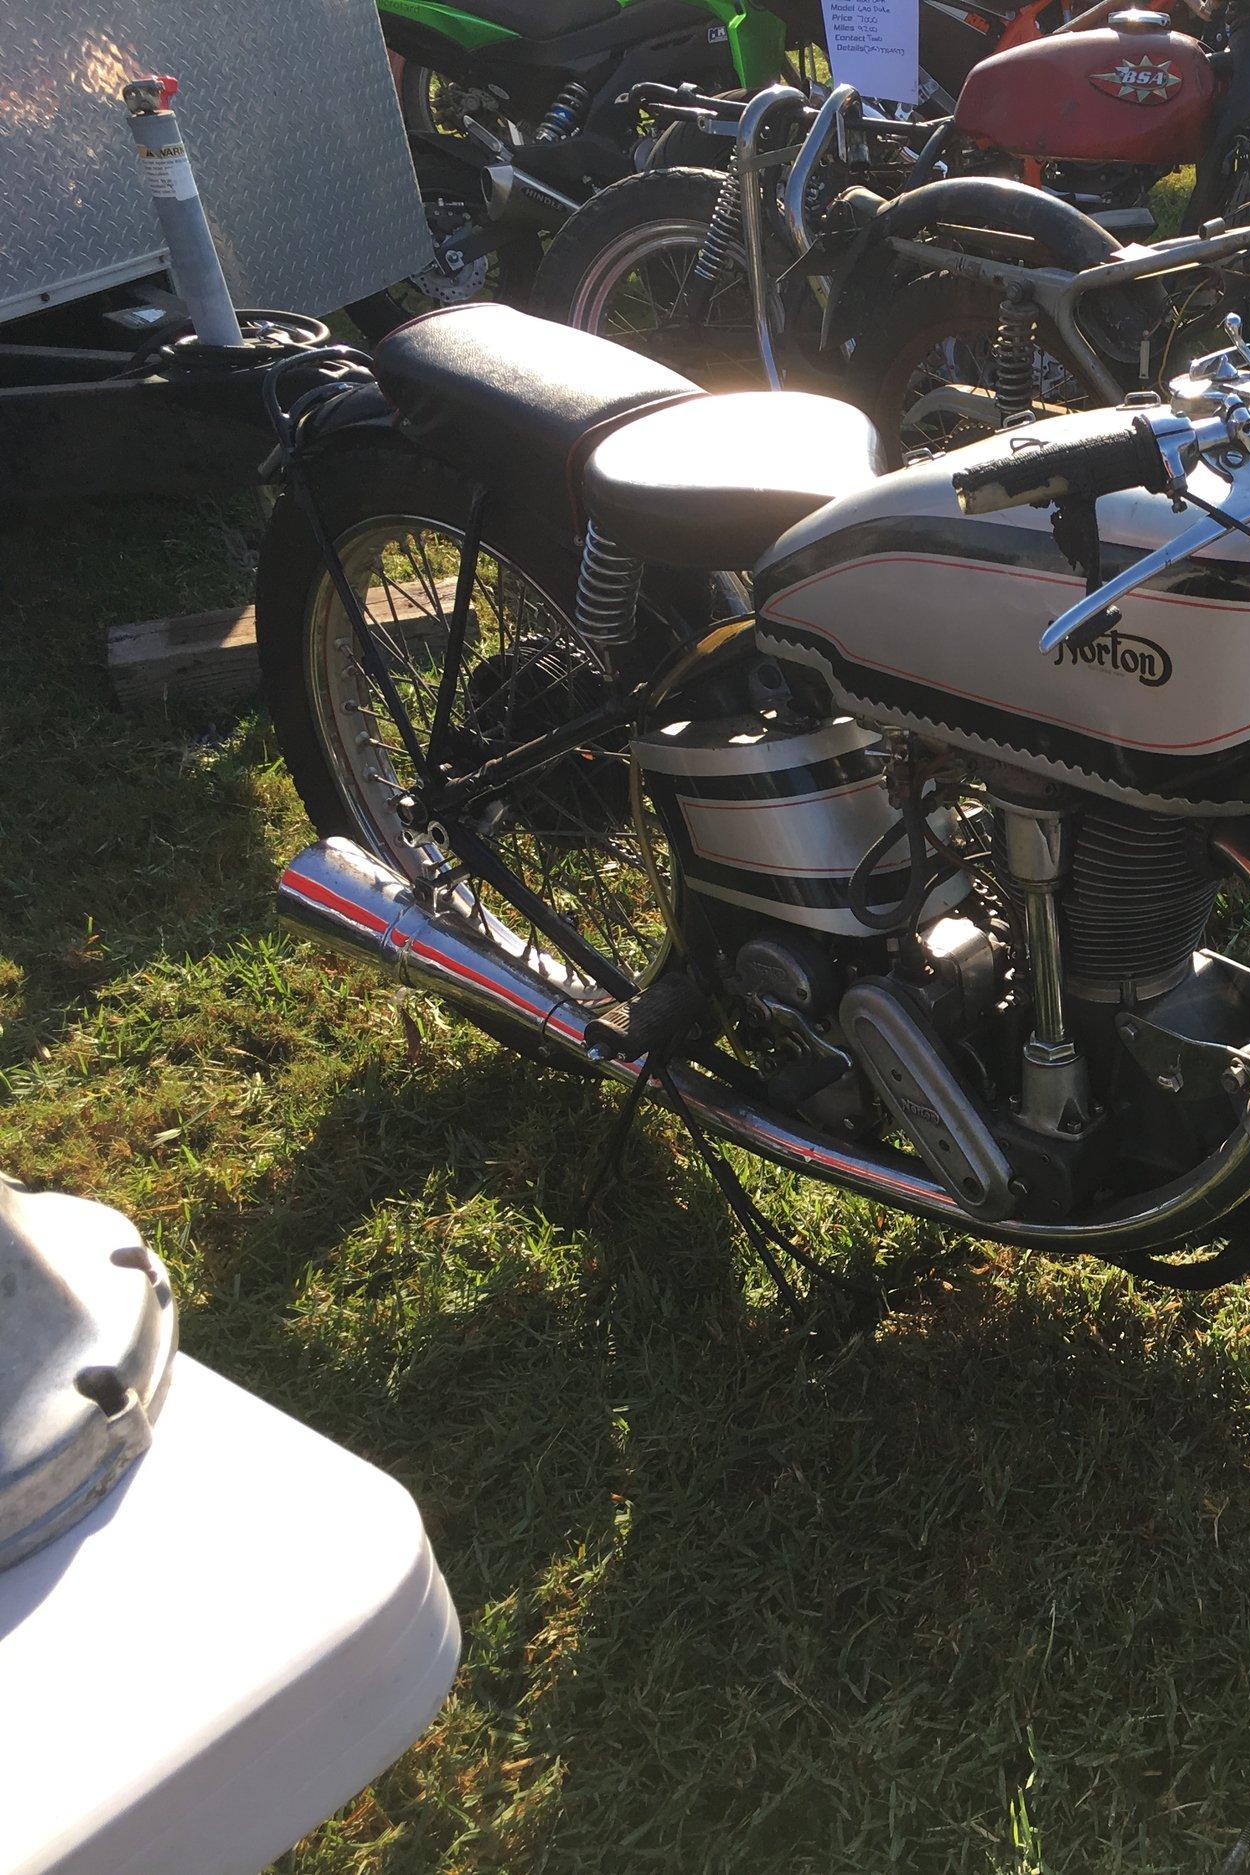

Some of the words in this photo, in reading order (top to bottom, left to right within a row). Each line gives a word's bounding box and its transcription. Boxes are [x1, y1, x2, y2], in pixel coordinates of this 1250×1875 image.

[832, 14, 853, 22] Price
[833, 24, 855, 32] Miles
[835, 34, 865, 42] Contact
[1120, 69, 1164, 84] BSA
[1054, 630, 1173, 687] Norton
